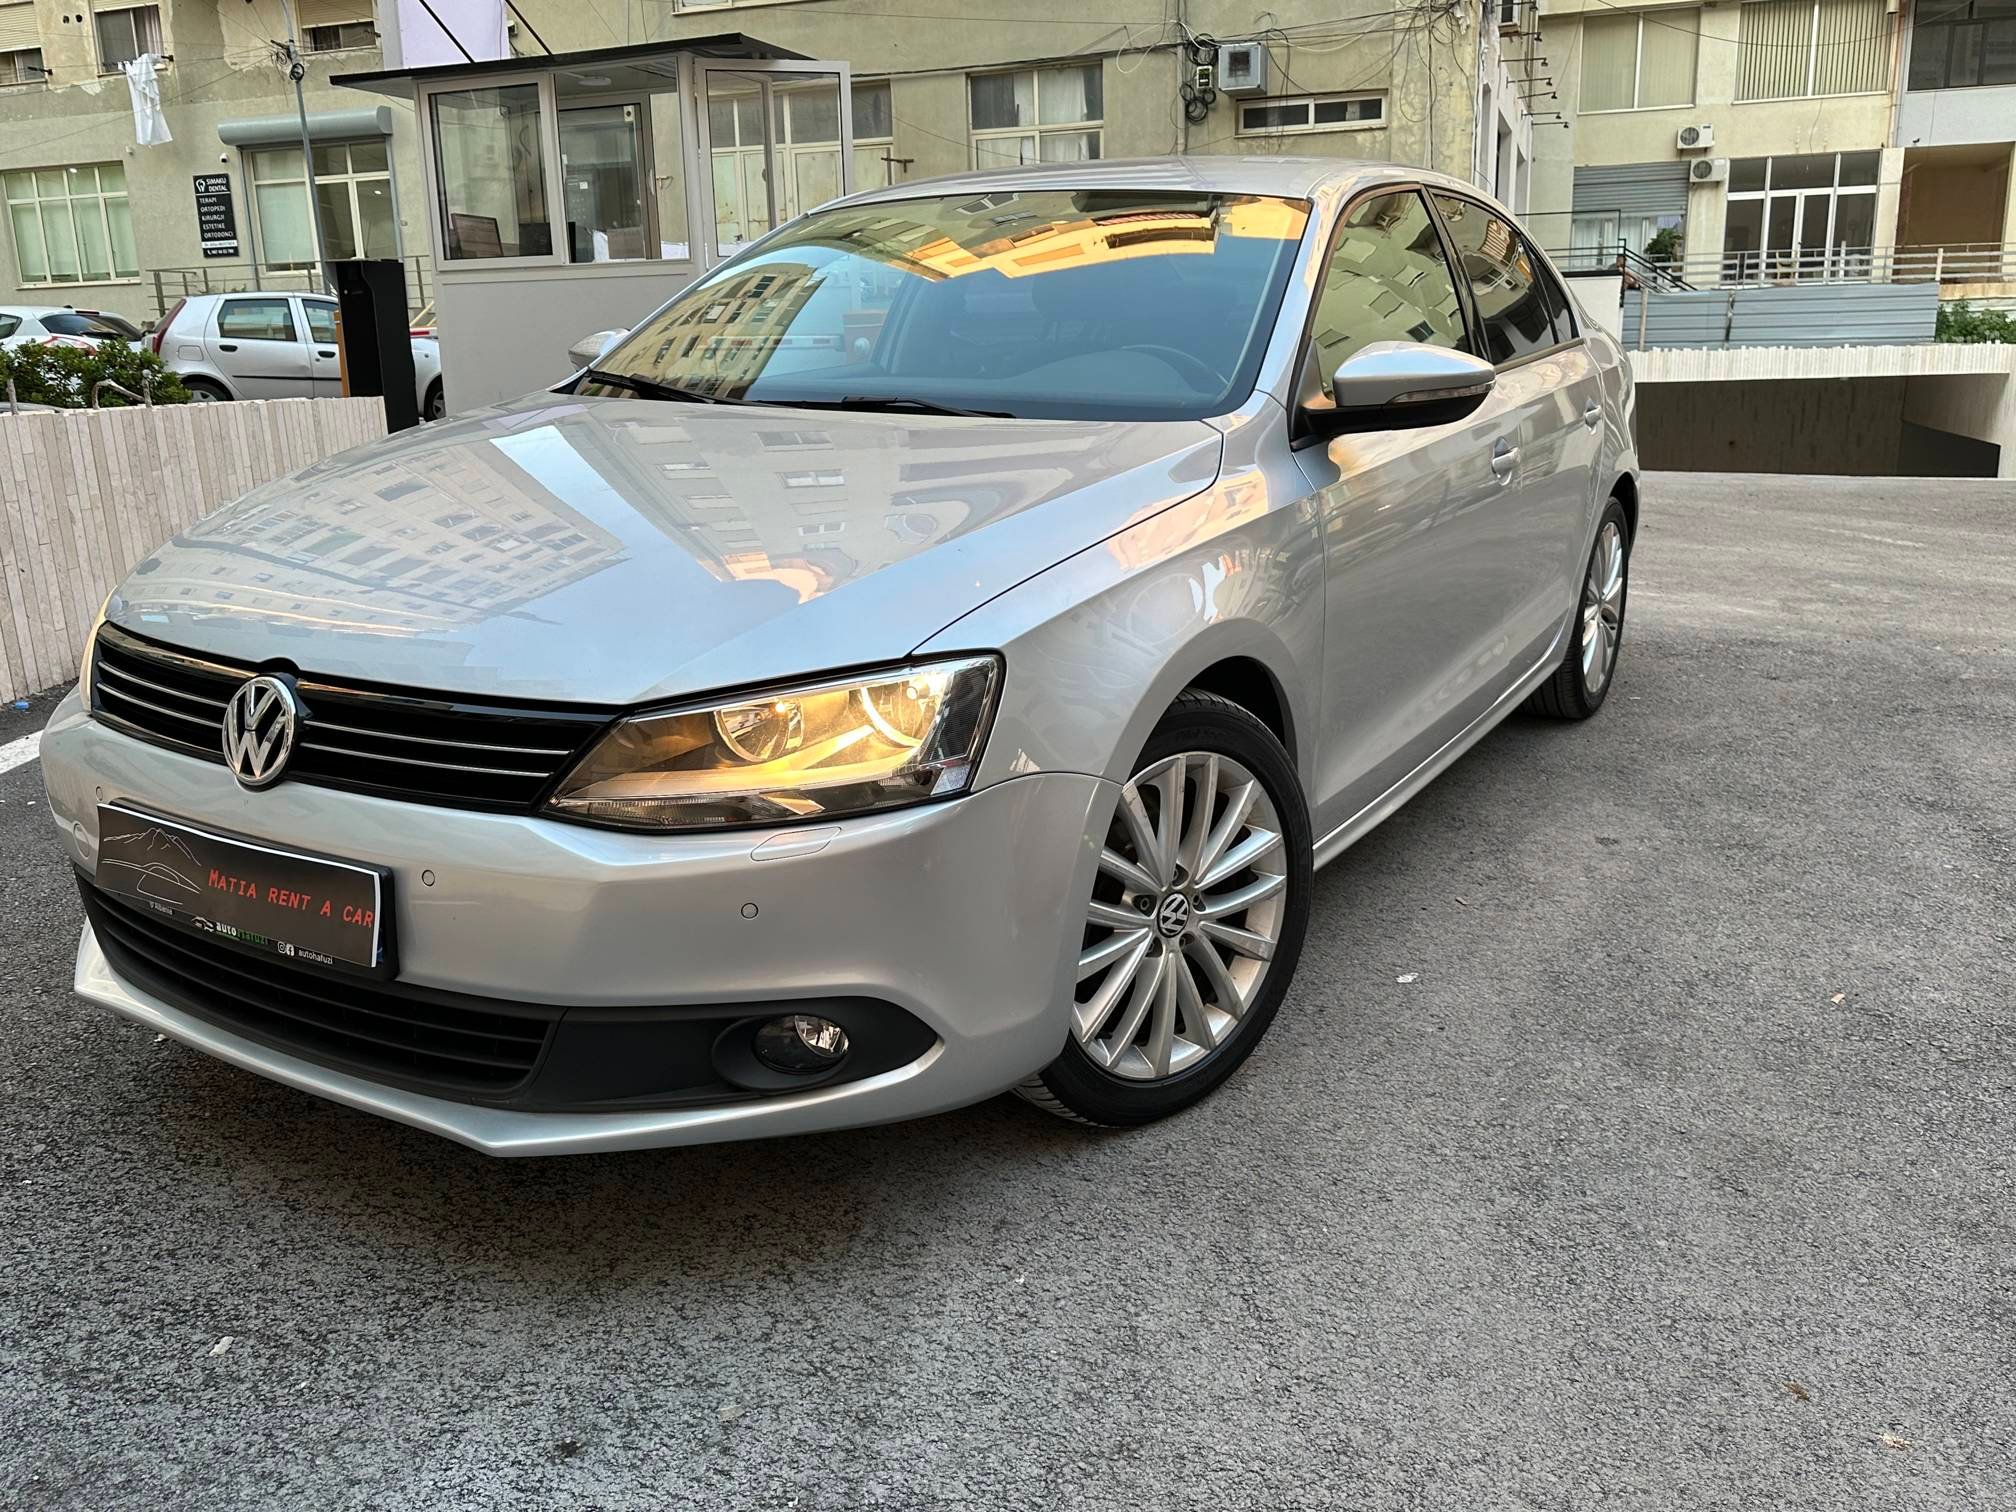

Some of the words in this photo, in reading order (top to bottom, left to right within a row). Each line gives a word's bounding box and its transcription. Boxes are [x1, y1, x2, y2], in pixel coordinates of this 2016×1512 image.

[267, 886, 312, 911] RENT
[319, 900, 332, 917] A
[343, 905, 374, 929] CAR
